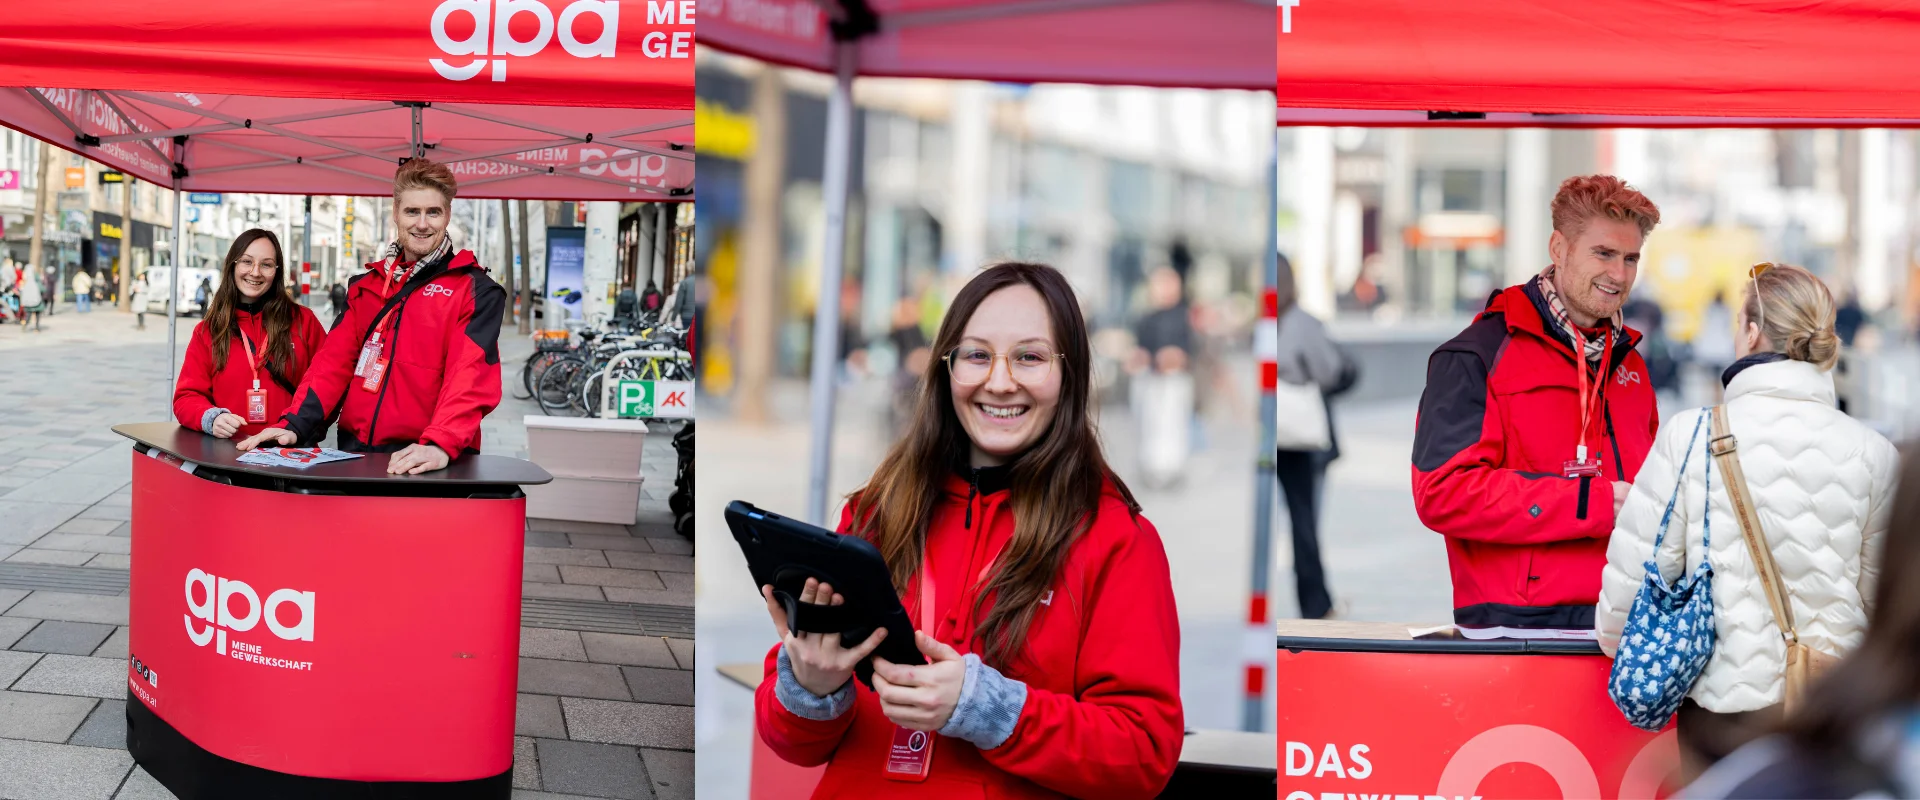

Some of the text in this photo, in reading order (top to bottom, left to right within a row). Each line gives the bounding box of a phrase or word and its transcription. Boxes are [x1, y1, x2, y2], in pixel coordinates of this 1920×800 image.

[429, 0, 620, 82] gpa
[641, 31, 696, 59] GE
[423, 283, 454, 297] gpa
[620, 382, 646, 414] P
[661, 391, 686, 407] AK
[183, 567, 316, 656] gpa
[231, 641, 262, 654] MEINE
[231, 650, 313, 671] GEWERKSCHAFT
[1284, 741, 1373, 780] DAS
